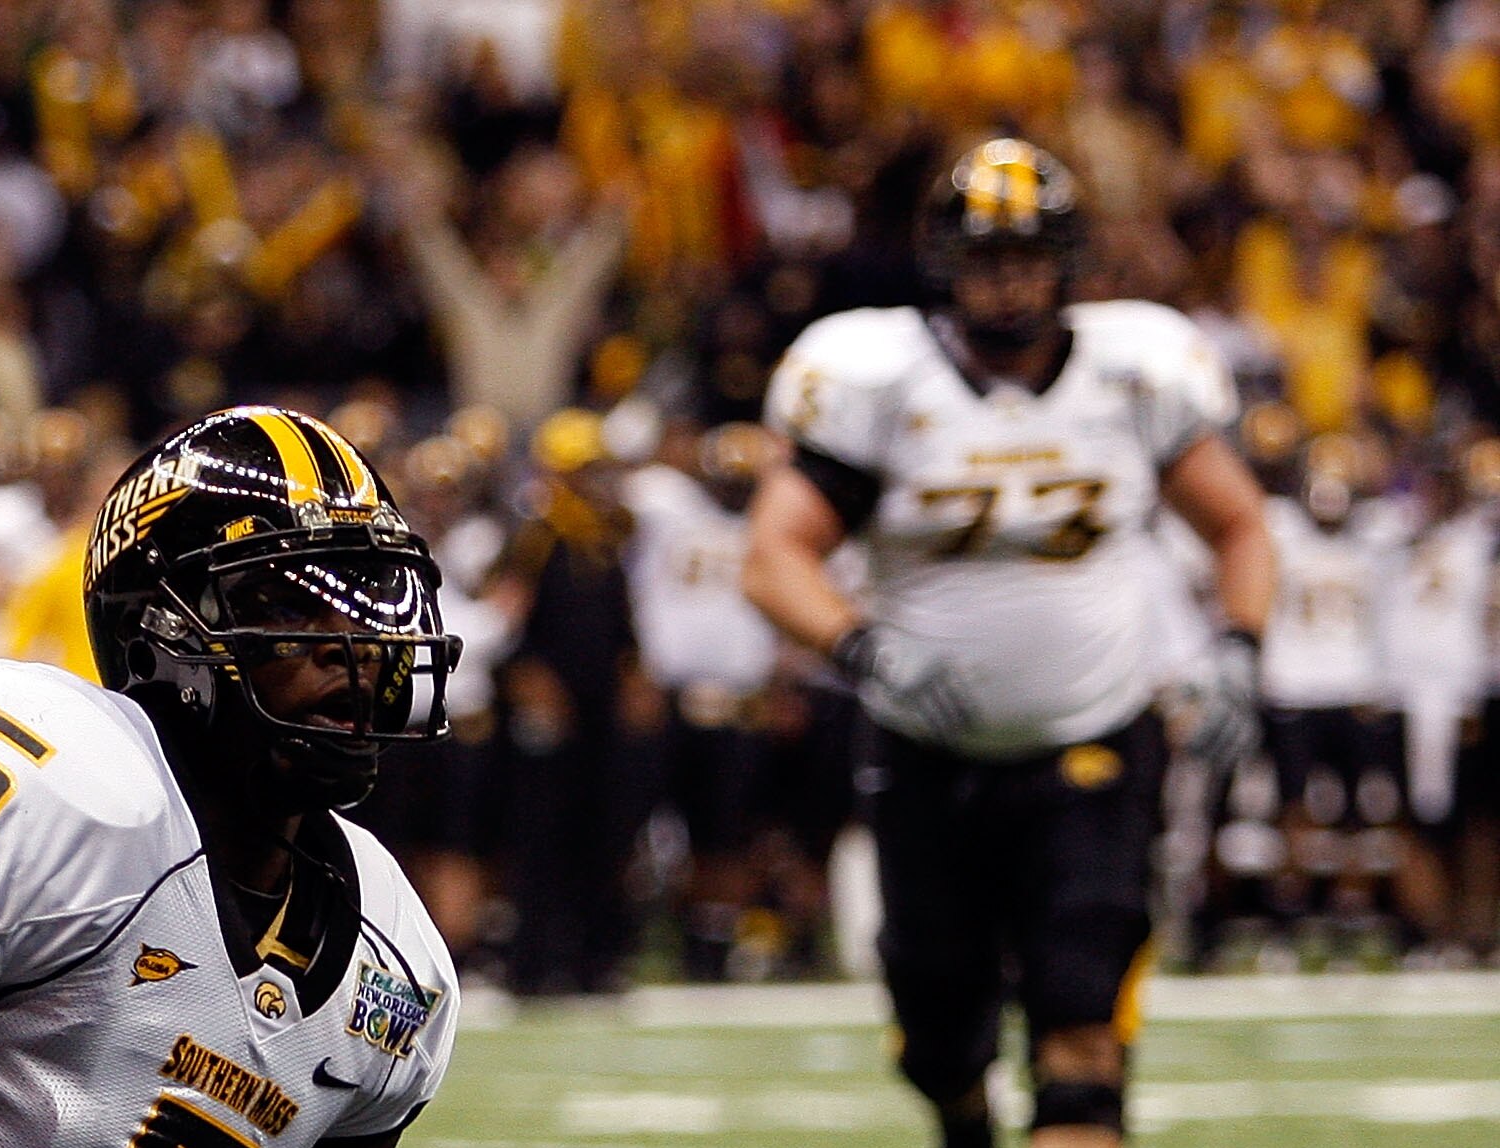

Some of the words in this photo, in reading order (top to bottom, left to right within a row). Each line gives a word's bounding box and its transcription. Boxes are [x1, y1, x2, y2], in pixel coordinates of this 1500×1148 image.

[225, 517, 255, 542] NIKE
[919, 477, 1111, 563] 73
[349, 998, 420, 1057] BOWL
[356, 982, 383, 1006] NEW
[383, 994, 430, 1025] ORLEANS
[158, 1033, 261, 1116] SOUTHERN
[248, 1075, 300, 1137] MISS
